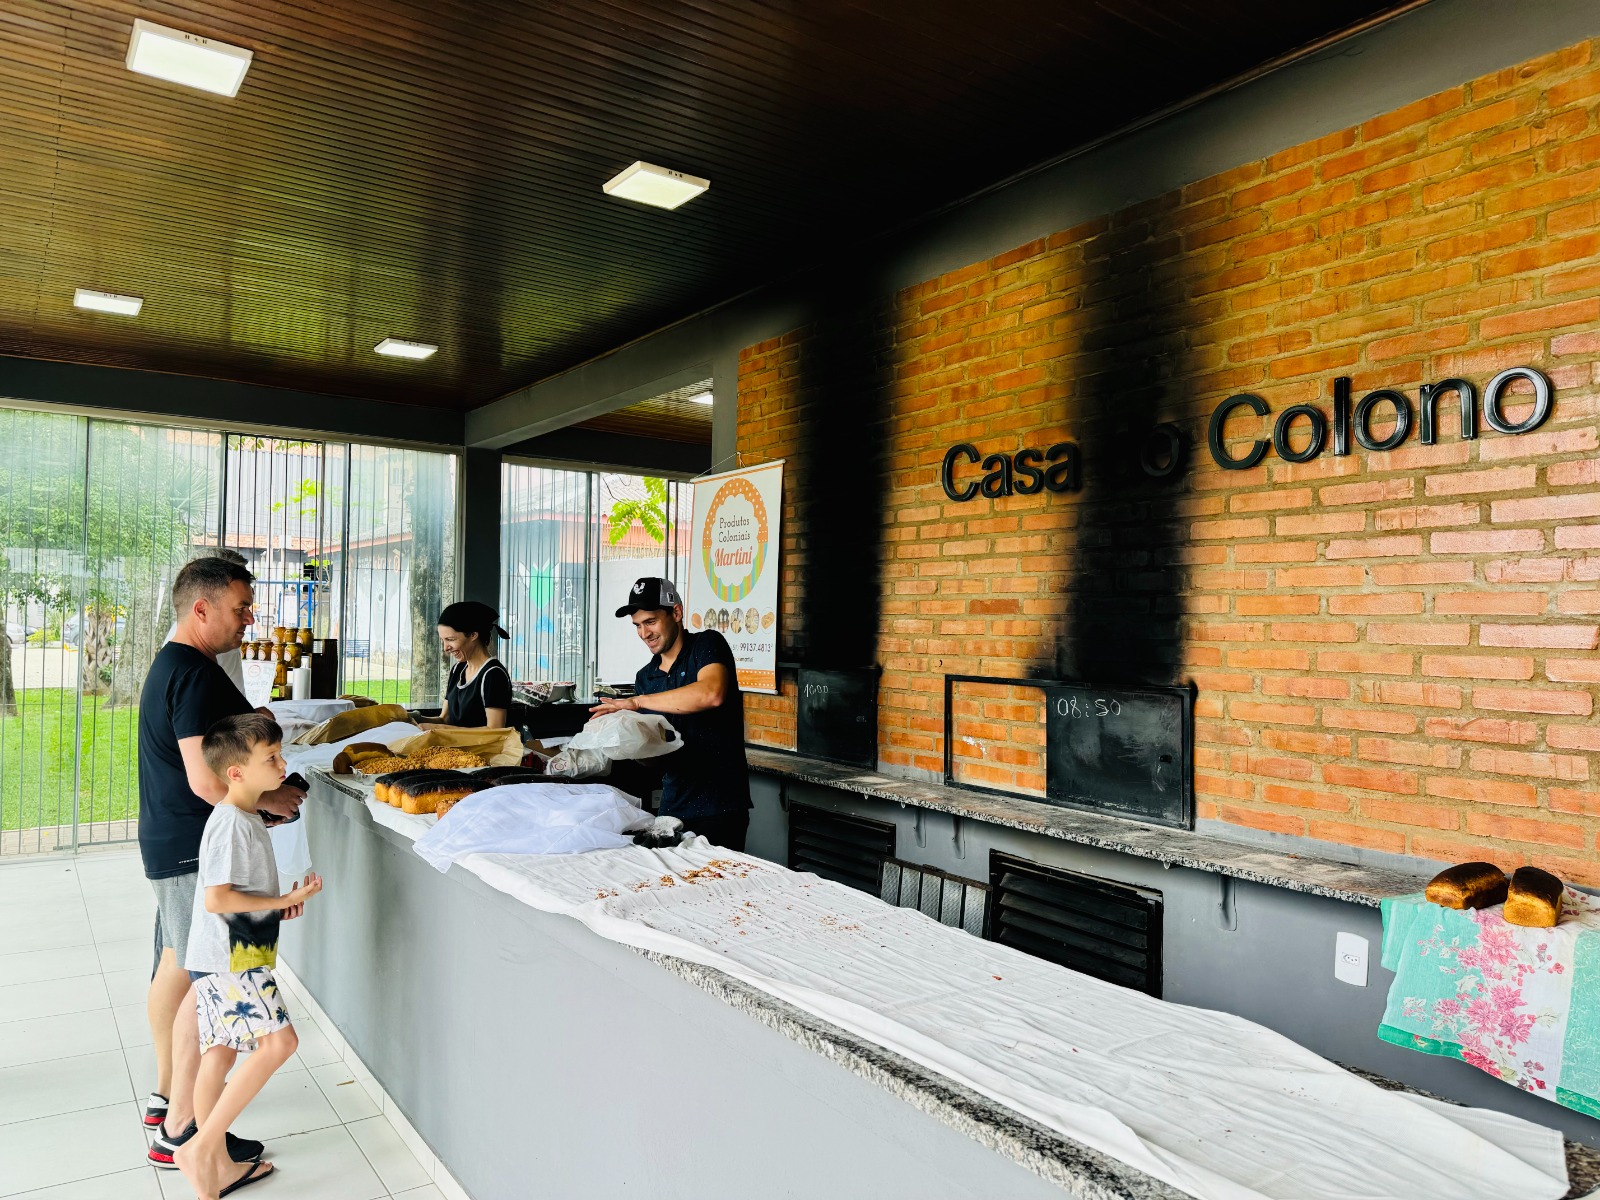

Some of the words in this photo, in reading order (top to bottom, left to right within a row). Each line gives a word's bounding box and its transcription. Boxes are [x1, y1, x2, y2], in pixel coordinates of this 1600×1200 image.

[942, 441, 1081, 501] Casa
[1208, 366, 1554, 471] Colono
[719, 514, 750, 529] Produtos
[718, 530, 751, 543] Coloniais
[715, 545, 753, 567] Martini
[1057, 695, 1121, 719] 08:50
